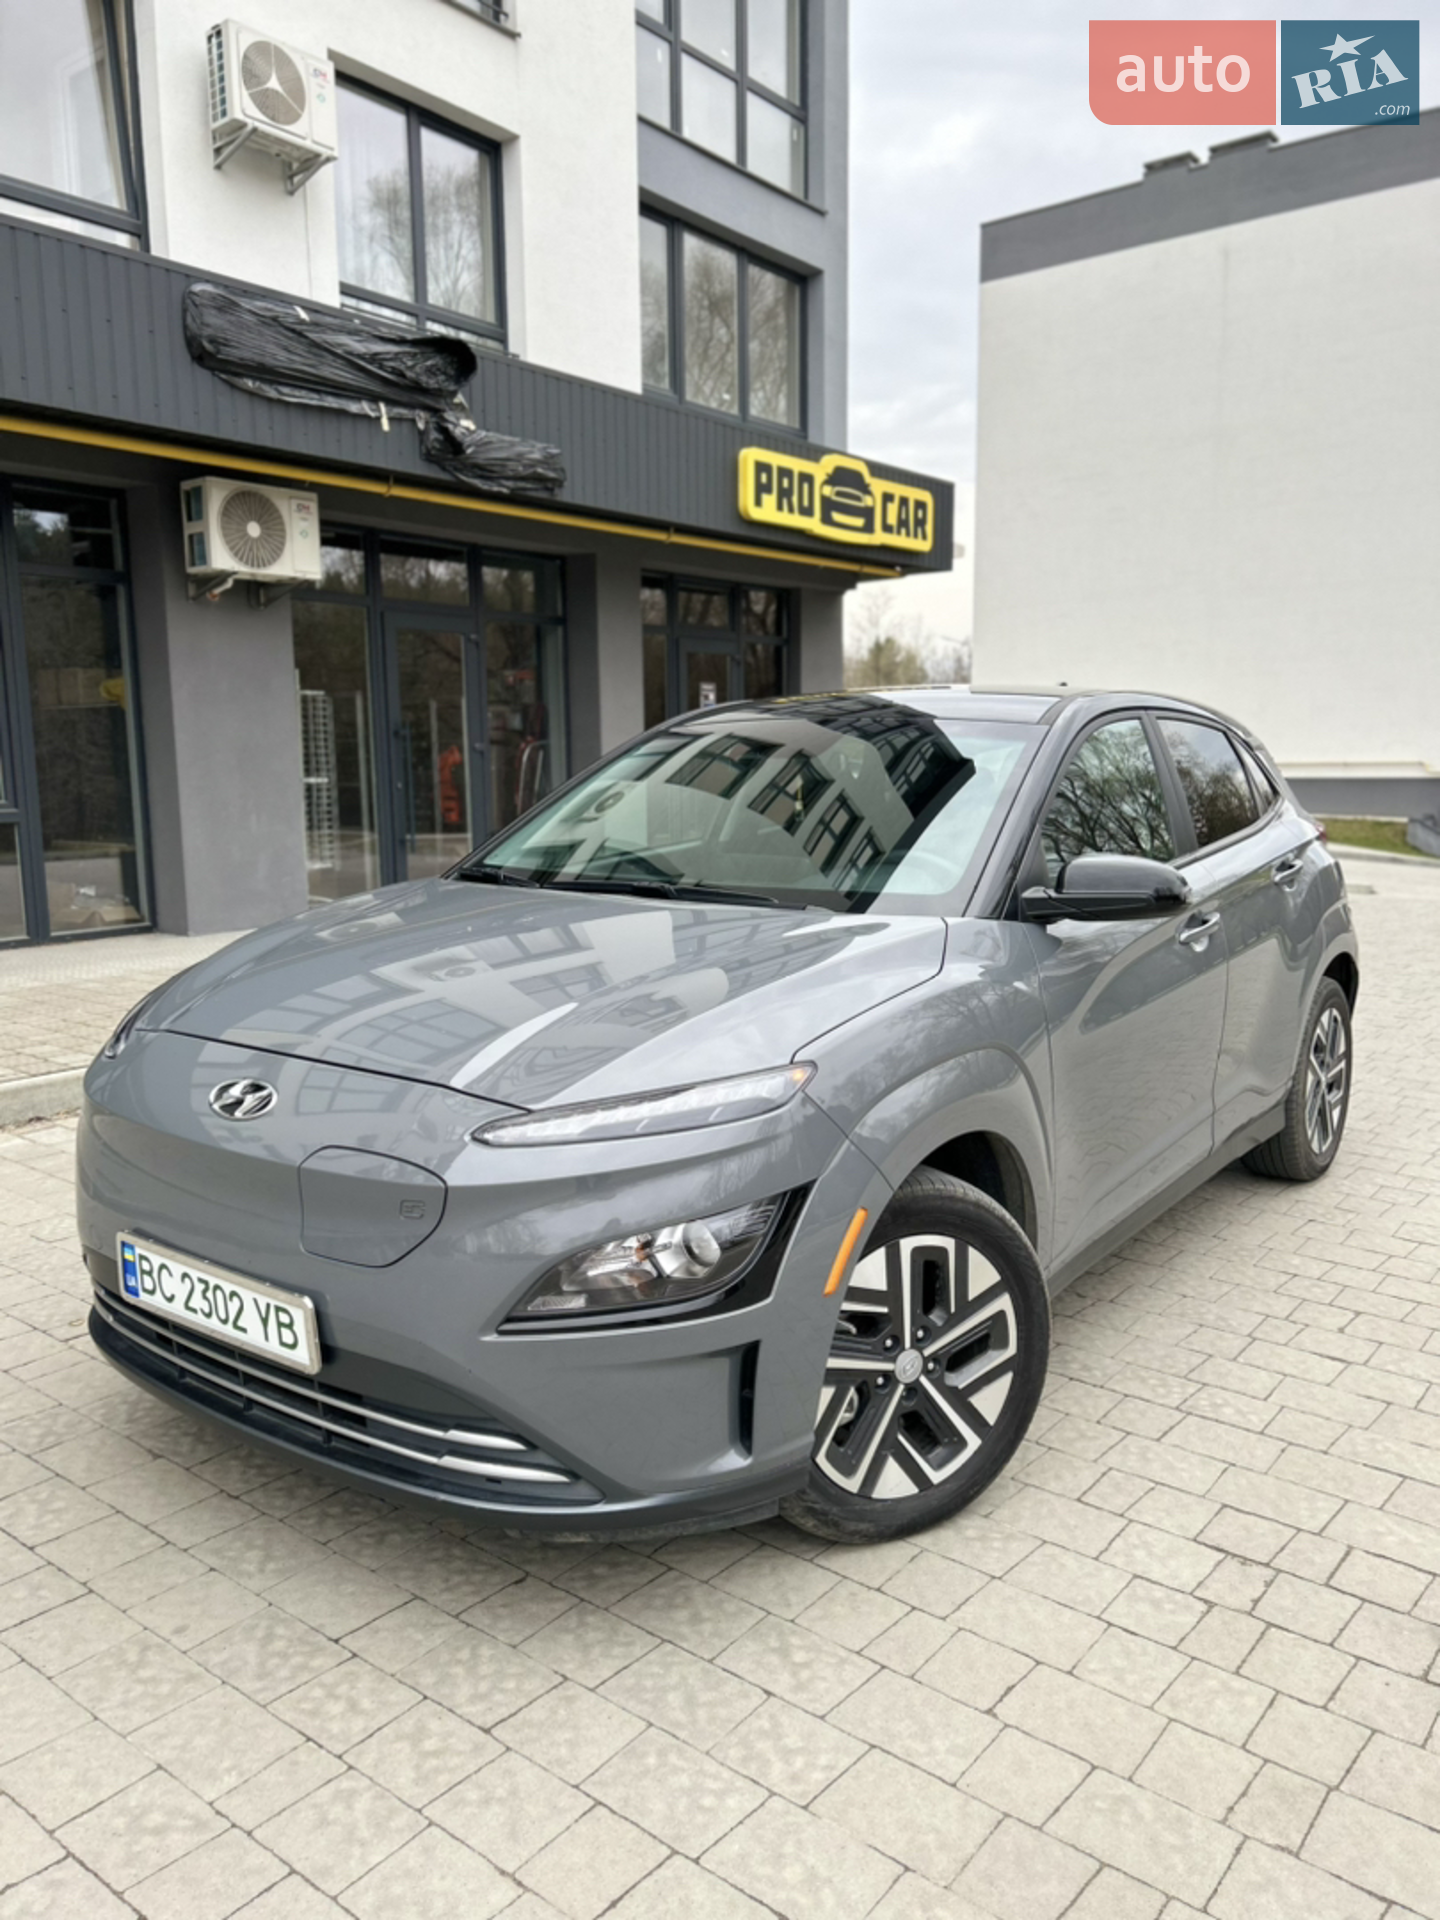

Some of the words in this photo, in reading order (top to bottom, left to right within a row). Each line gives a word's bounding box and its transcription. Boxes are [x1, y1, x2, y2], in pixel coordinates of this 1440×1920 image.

[754, 460, 815, 518] PRO
[881, 491, 928, 541] CAR
[138, 1253, 175, 1304] BC
[181, 1271, 248, 1334] 2302
[253, 1297, 299, 1350] YB
